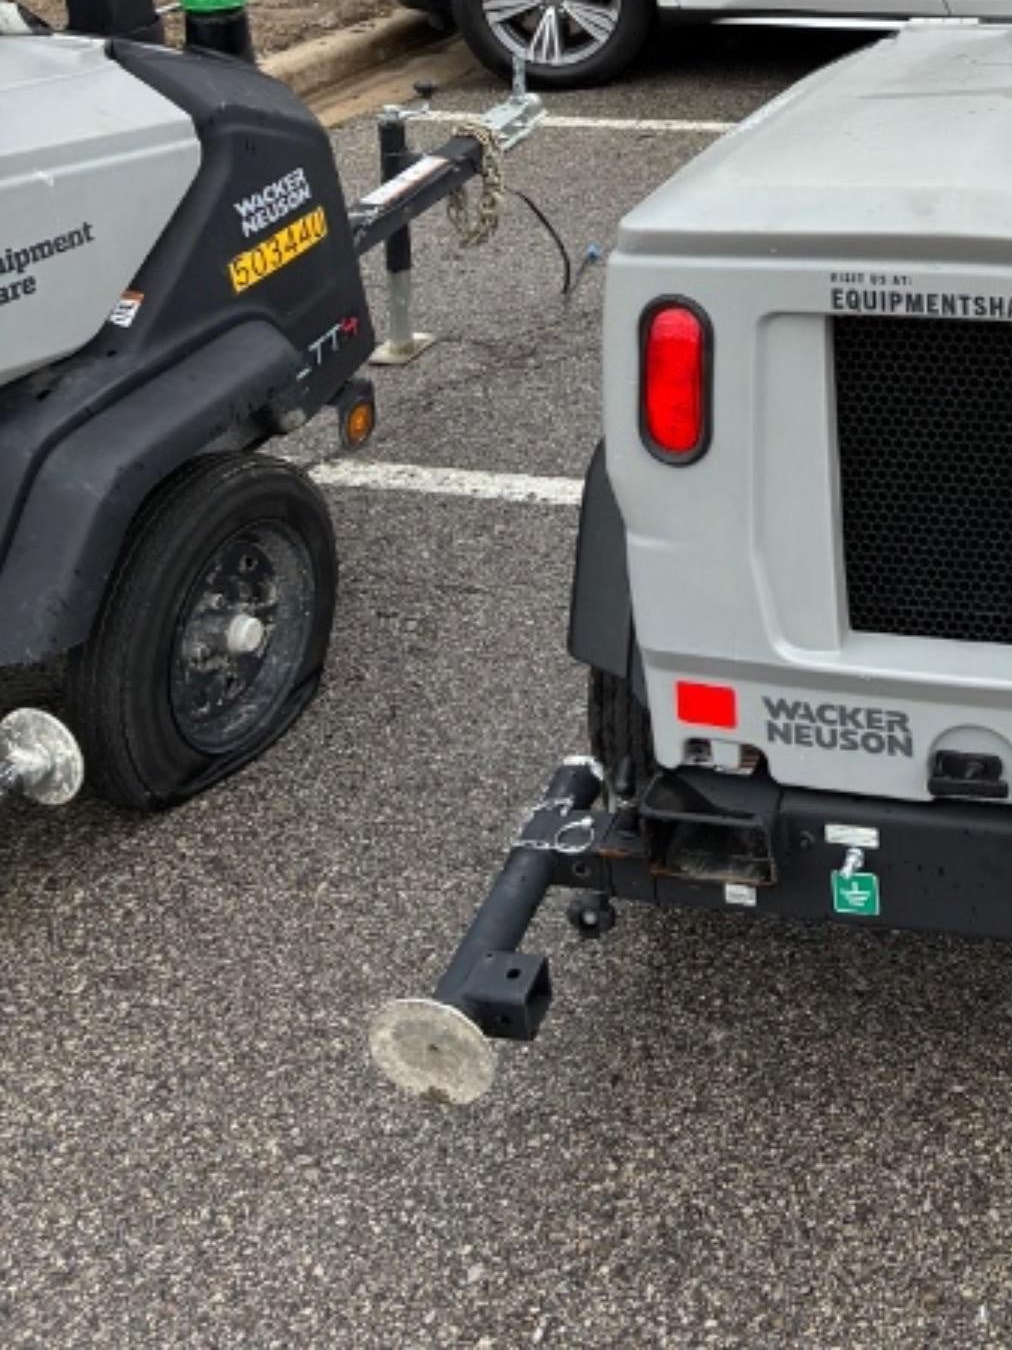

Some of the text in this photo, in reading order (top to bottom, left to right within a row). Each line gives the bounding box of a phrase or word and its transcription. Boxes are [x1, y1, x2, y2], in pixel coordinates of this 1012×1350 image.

[233, 167, 306, 217] WACKER
[242, 184, 312, 238] NEUSON
[762, 695, 912, 733] WACKER
[766, 719, 914, 758] NEUSON
